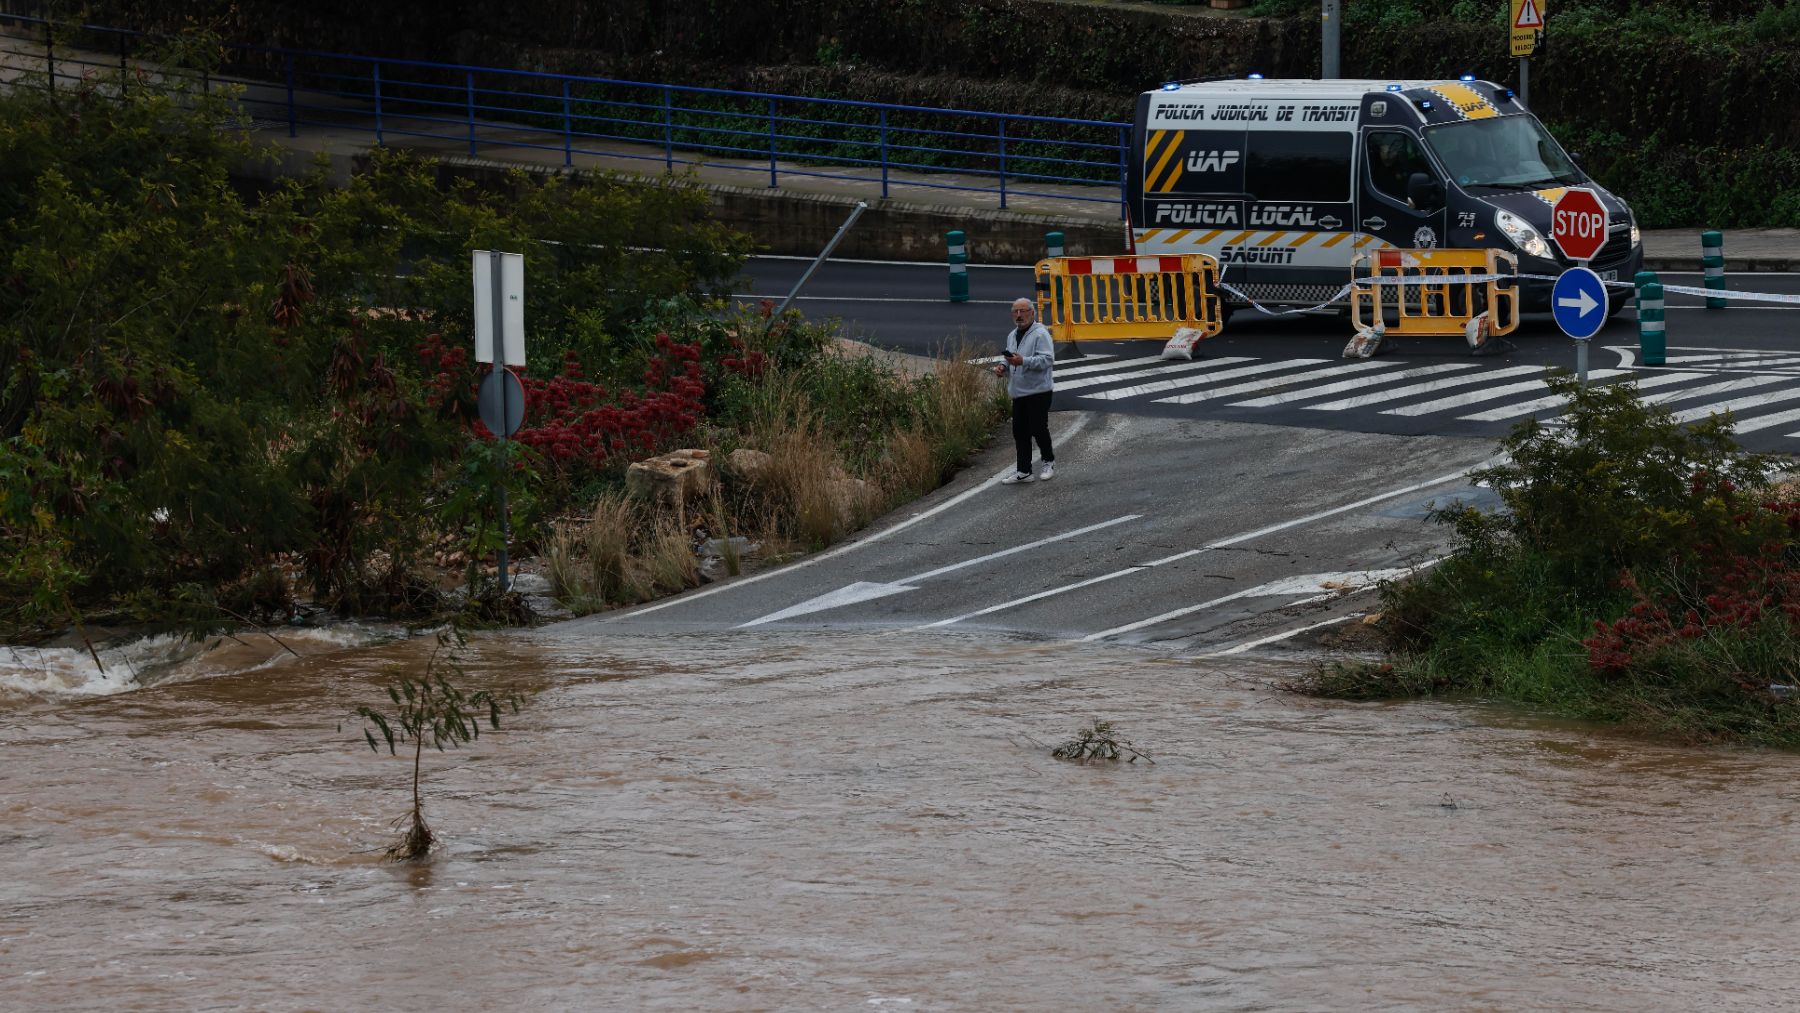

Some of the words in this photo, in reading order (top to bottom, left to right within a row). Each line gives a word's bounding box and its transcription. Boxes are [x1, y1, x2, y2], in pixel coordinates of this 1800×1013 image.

[1155, 104, 1204, 120] POLICIA
[1211, 104, 1268, 121] JUDICIAL
[1275, 105, 1295, 122] DE
[1302, 105, 1360, 122] TRANSIT
[1187, 150, 1240, 172] UAP
[1155, 204, 1239, 224] POLICIA
[1249, 205, 1317, 226] LOCAL
[1555, 209, 1603, 239] STOP
[1219, 246, 1297, 264] SAGUNT
